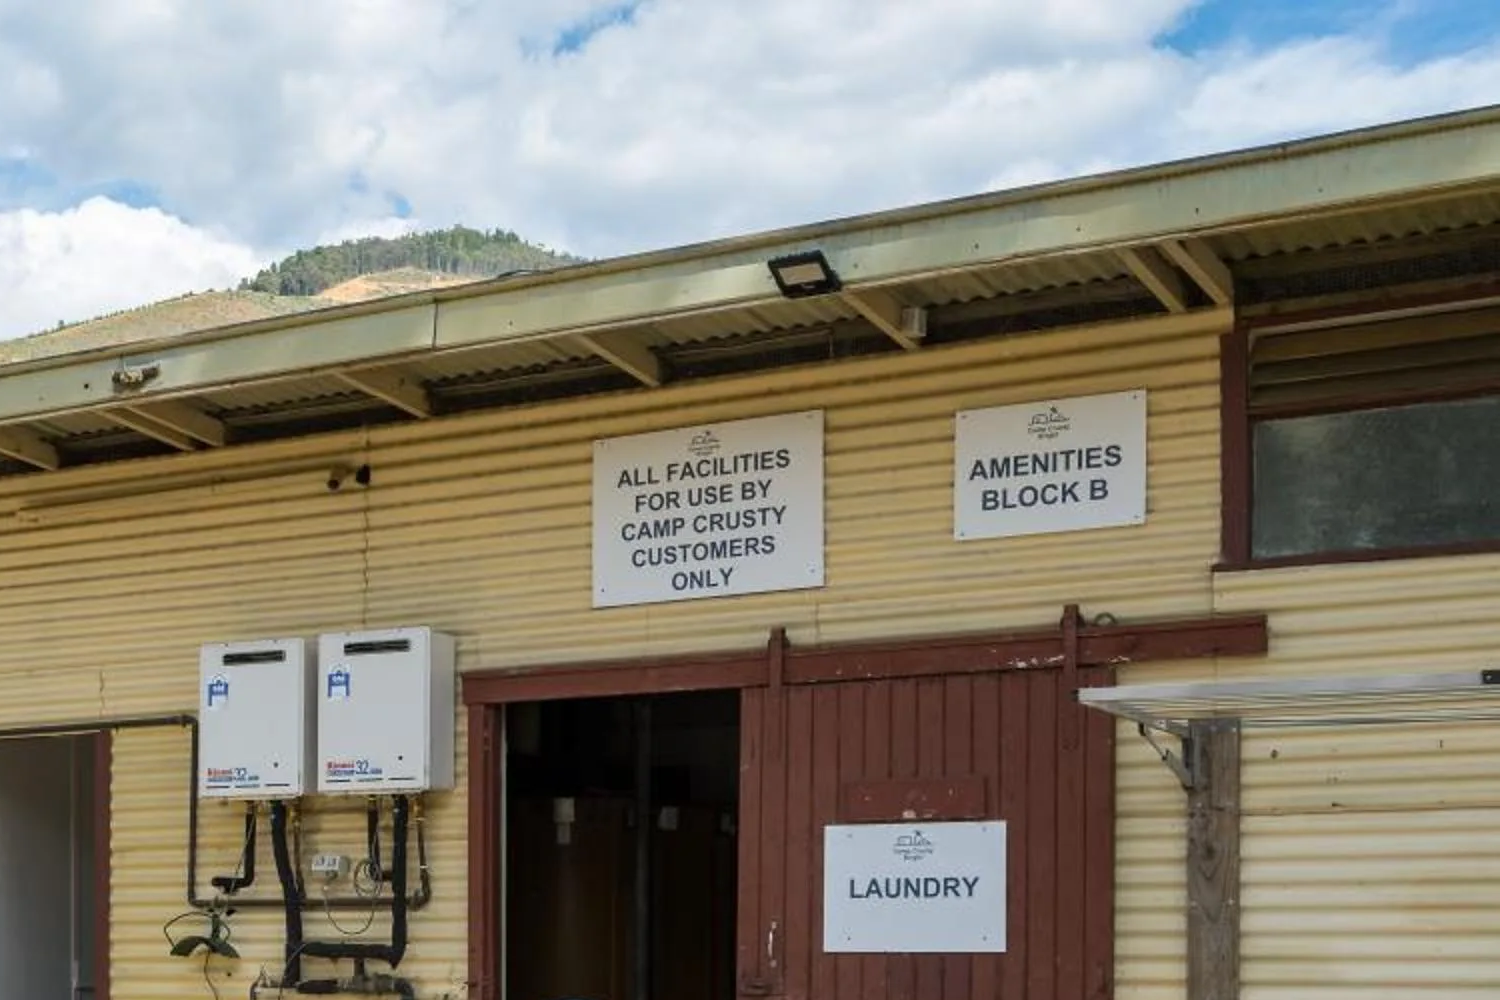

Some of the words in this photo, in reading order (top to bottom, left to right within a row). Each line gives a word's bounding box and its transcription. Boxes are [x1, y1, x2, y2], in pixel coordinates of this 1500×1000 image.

[617, 466, 659, 488] ALL
[666, 449, 790, 482] FACILITIES
[969, 445, 1122, 480] AMENITIES
[635, 490, 680, 513] FOR
[688, 484, 733, 507] USE
[741, 479, 772, 501] BY
[981, 481, 1080, 511] BLOCK
[1089, 479, 1109, 501] B
[621, 517, 685, 541] CAMP
[693, 505, 787, 533] CRUSTY
[632, 535, 775, 567] CUSTOMERS
[671, 567, 733, 591] ONLY
[850, 876, 979, 899] LAUNDRY
